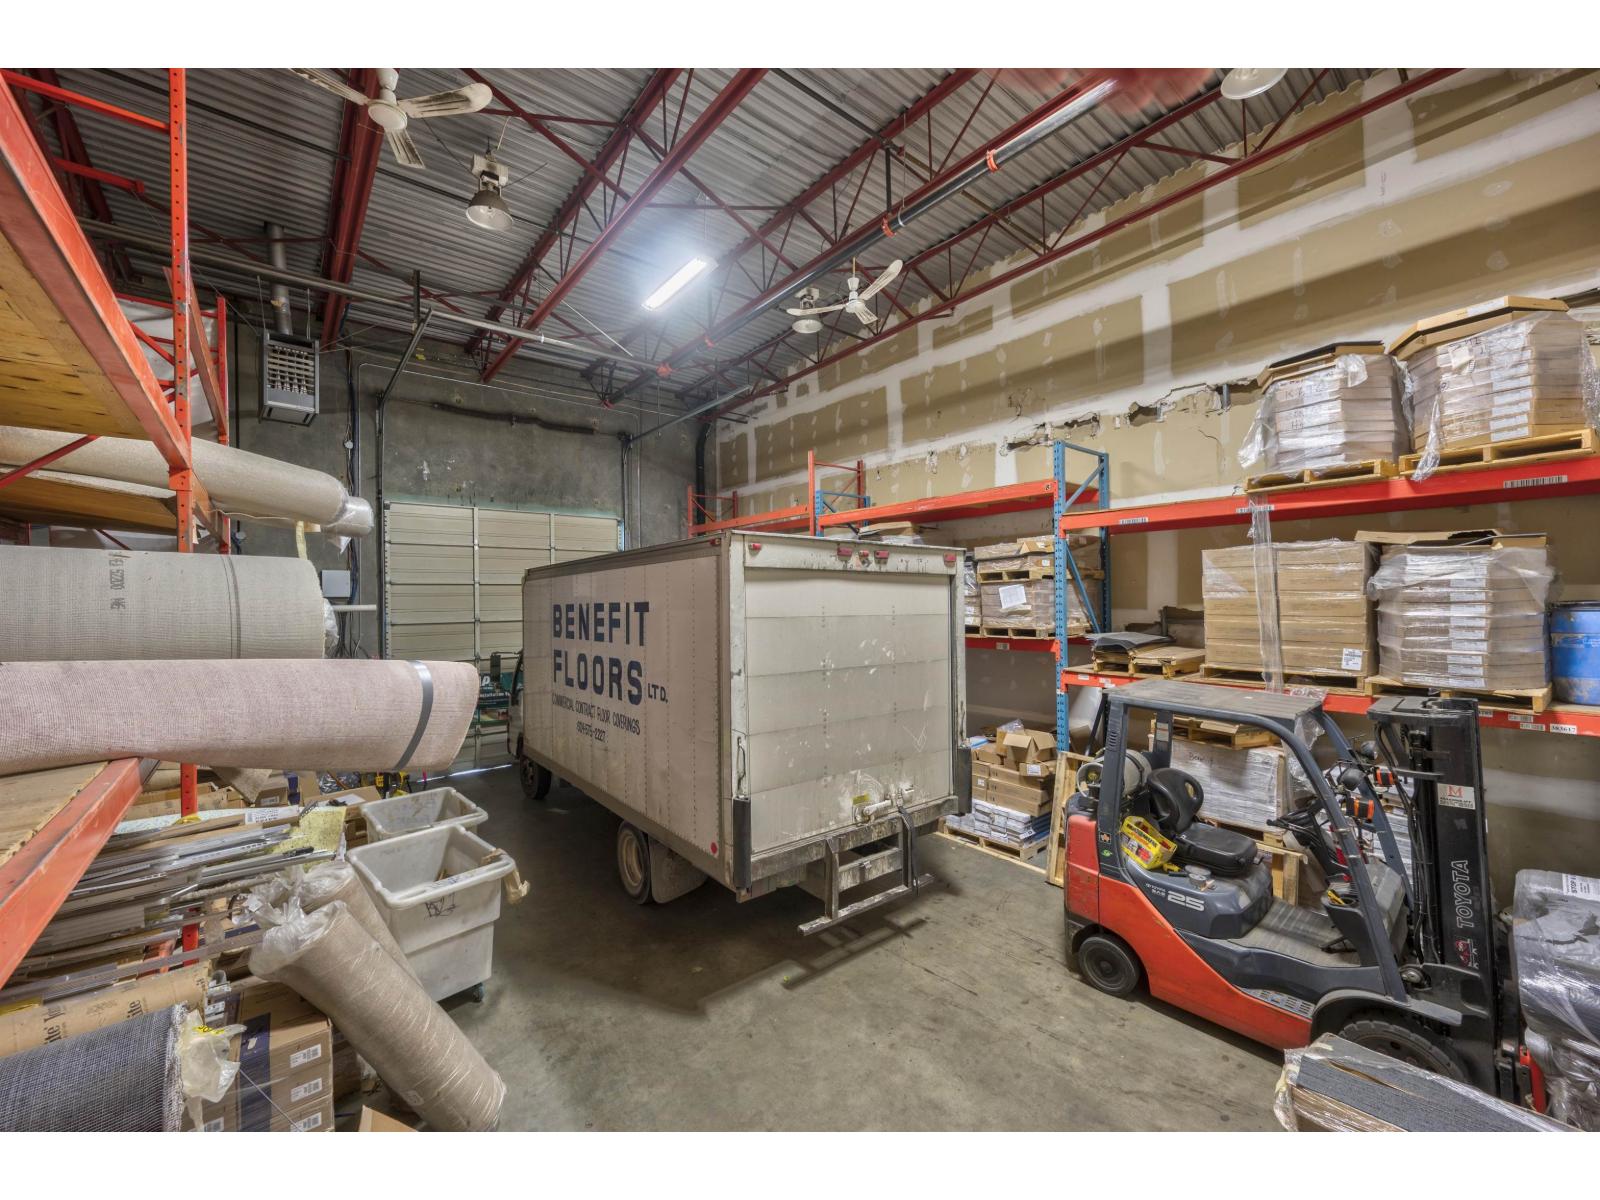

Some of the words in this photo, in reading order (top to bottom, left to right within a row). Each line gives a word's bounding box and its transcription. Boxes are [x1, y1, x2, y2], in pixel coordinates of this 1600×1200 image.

[553, 601, 650, 646] BENEFIT
[553, 649, 643, 706] FLOORS
[647, 682, 669, 704] LTD.
[575, 700, 596, 719] CONTRACT
[597, 706, 611, 724] FLOOR
[612, 711, 641, 736] COVERINGS
[1447, 785, 1464, 799] M
[1167, 890, 1205, 912] 25
[1450, 859, 1475, 929] TOYOTA
